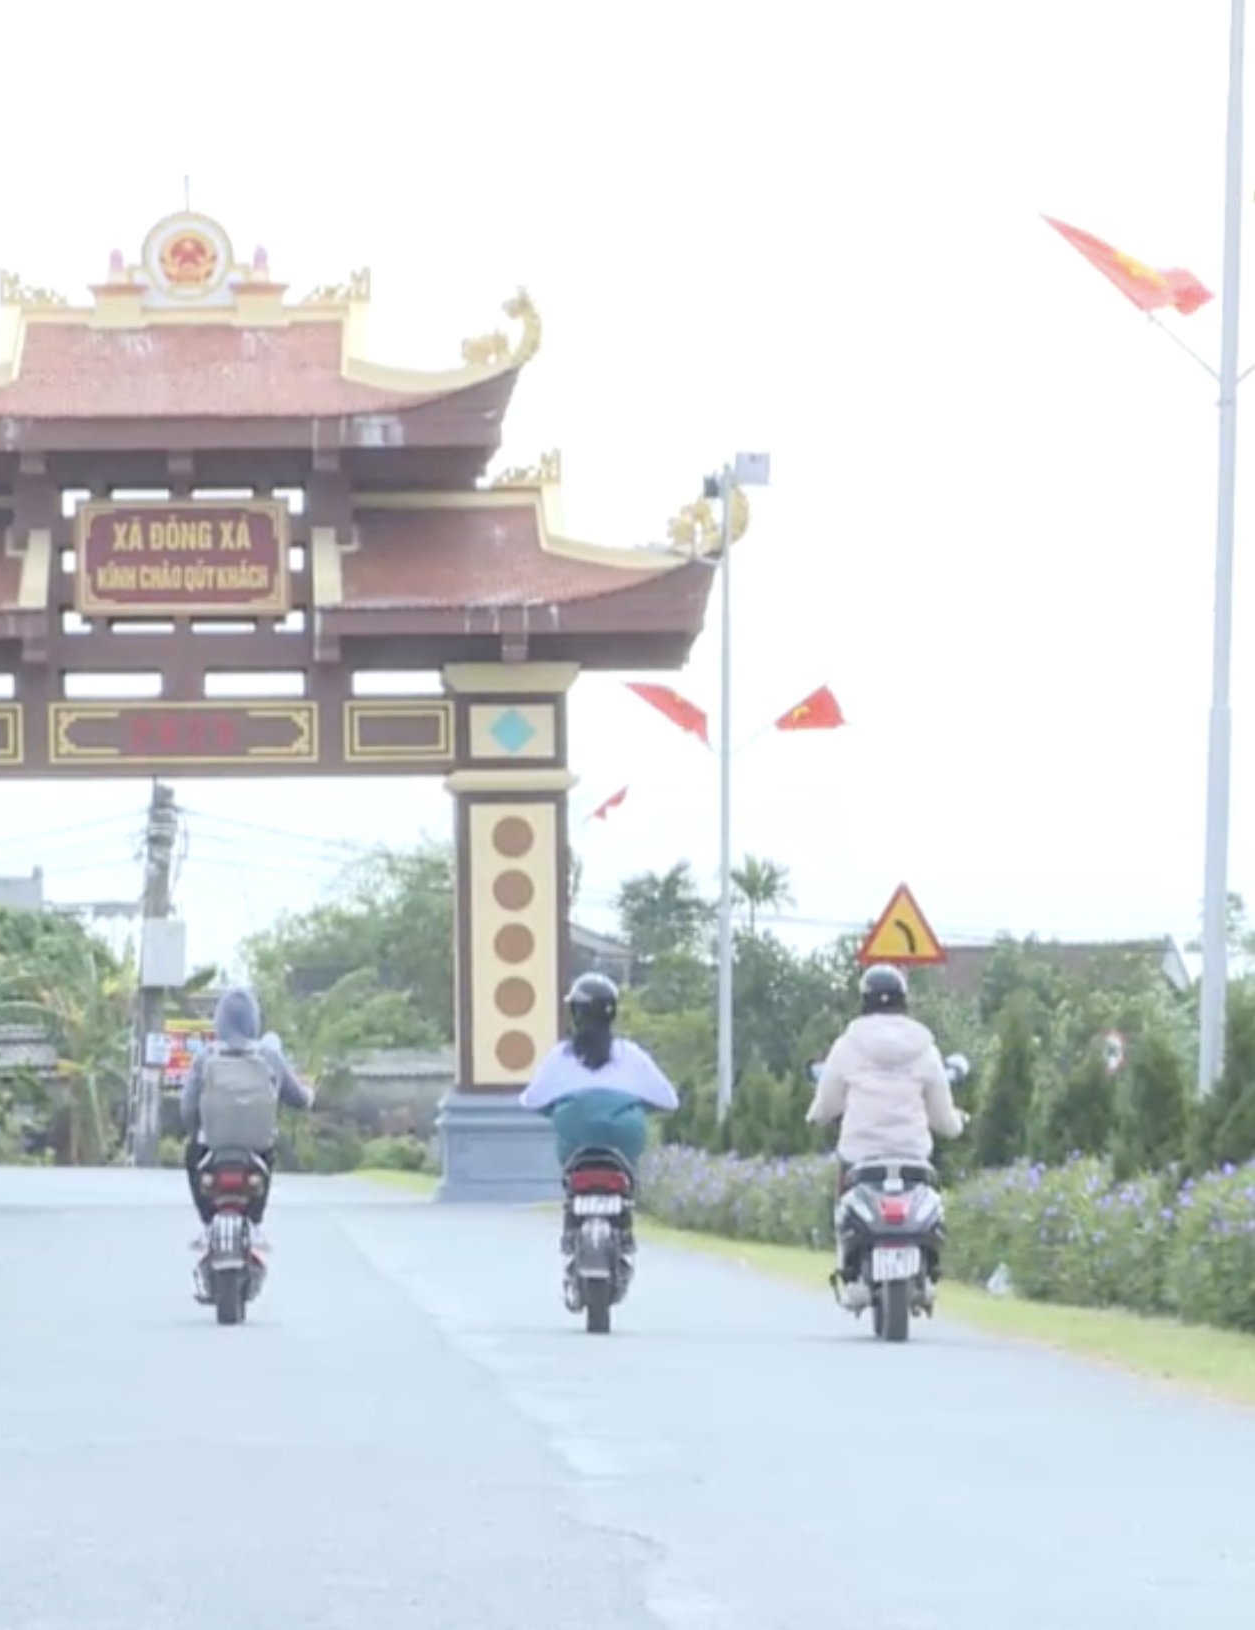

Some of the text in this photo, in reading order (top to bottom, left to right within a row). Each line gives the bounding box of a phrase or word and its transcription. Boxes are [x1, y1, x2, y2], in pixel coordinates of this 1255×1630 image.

[112, 514, 251, 551] XÃ ĐÔNG XÁ
[97, 560, 137, 590] KÍNH
[140, 559, 181, 590] CHÀO
[216, 559, 269, 590] KHÁCH
